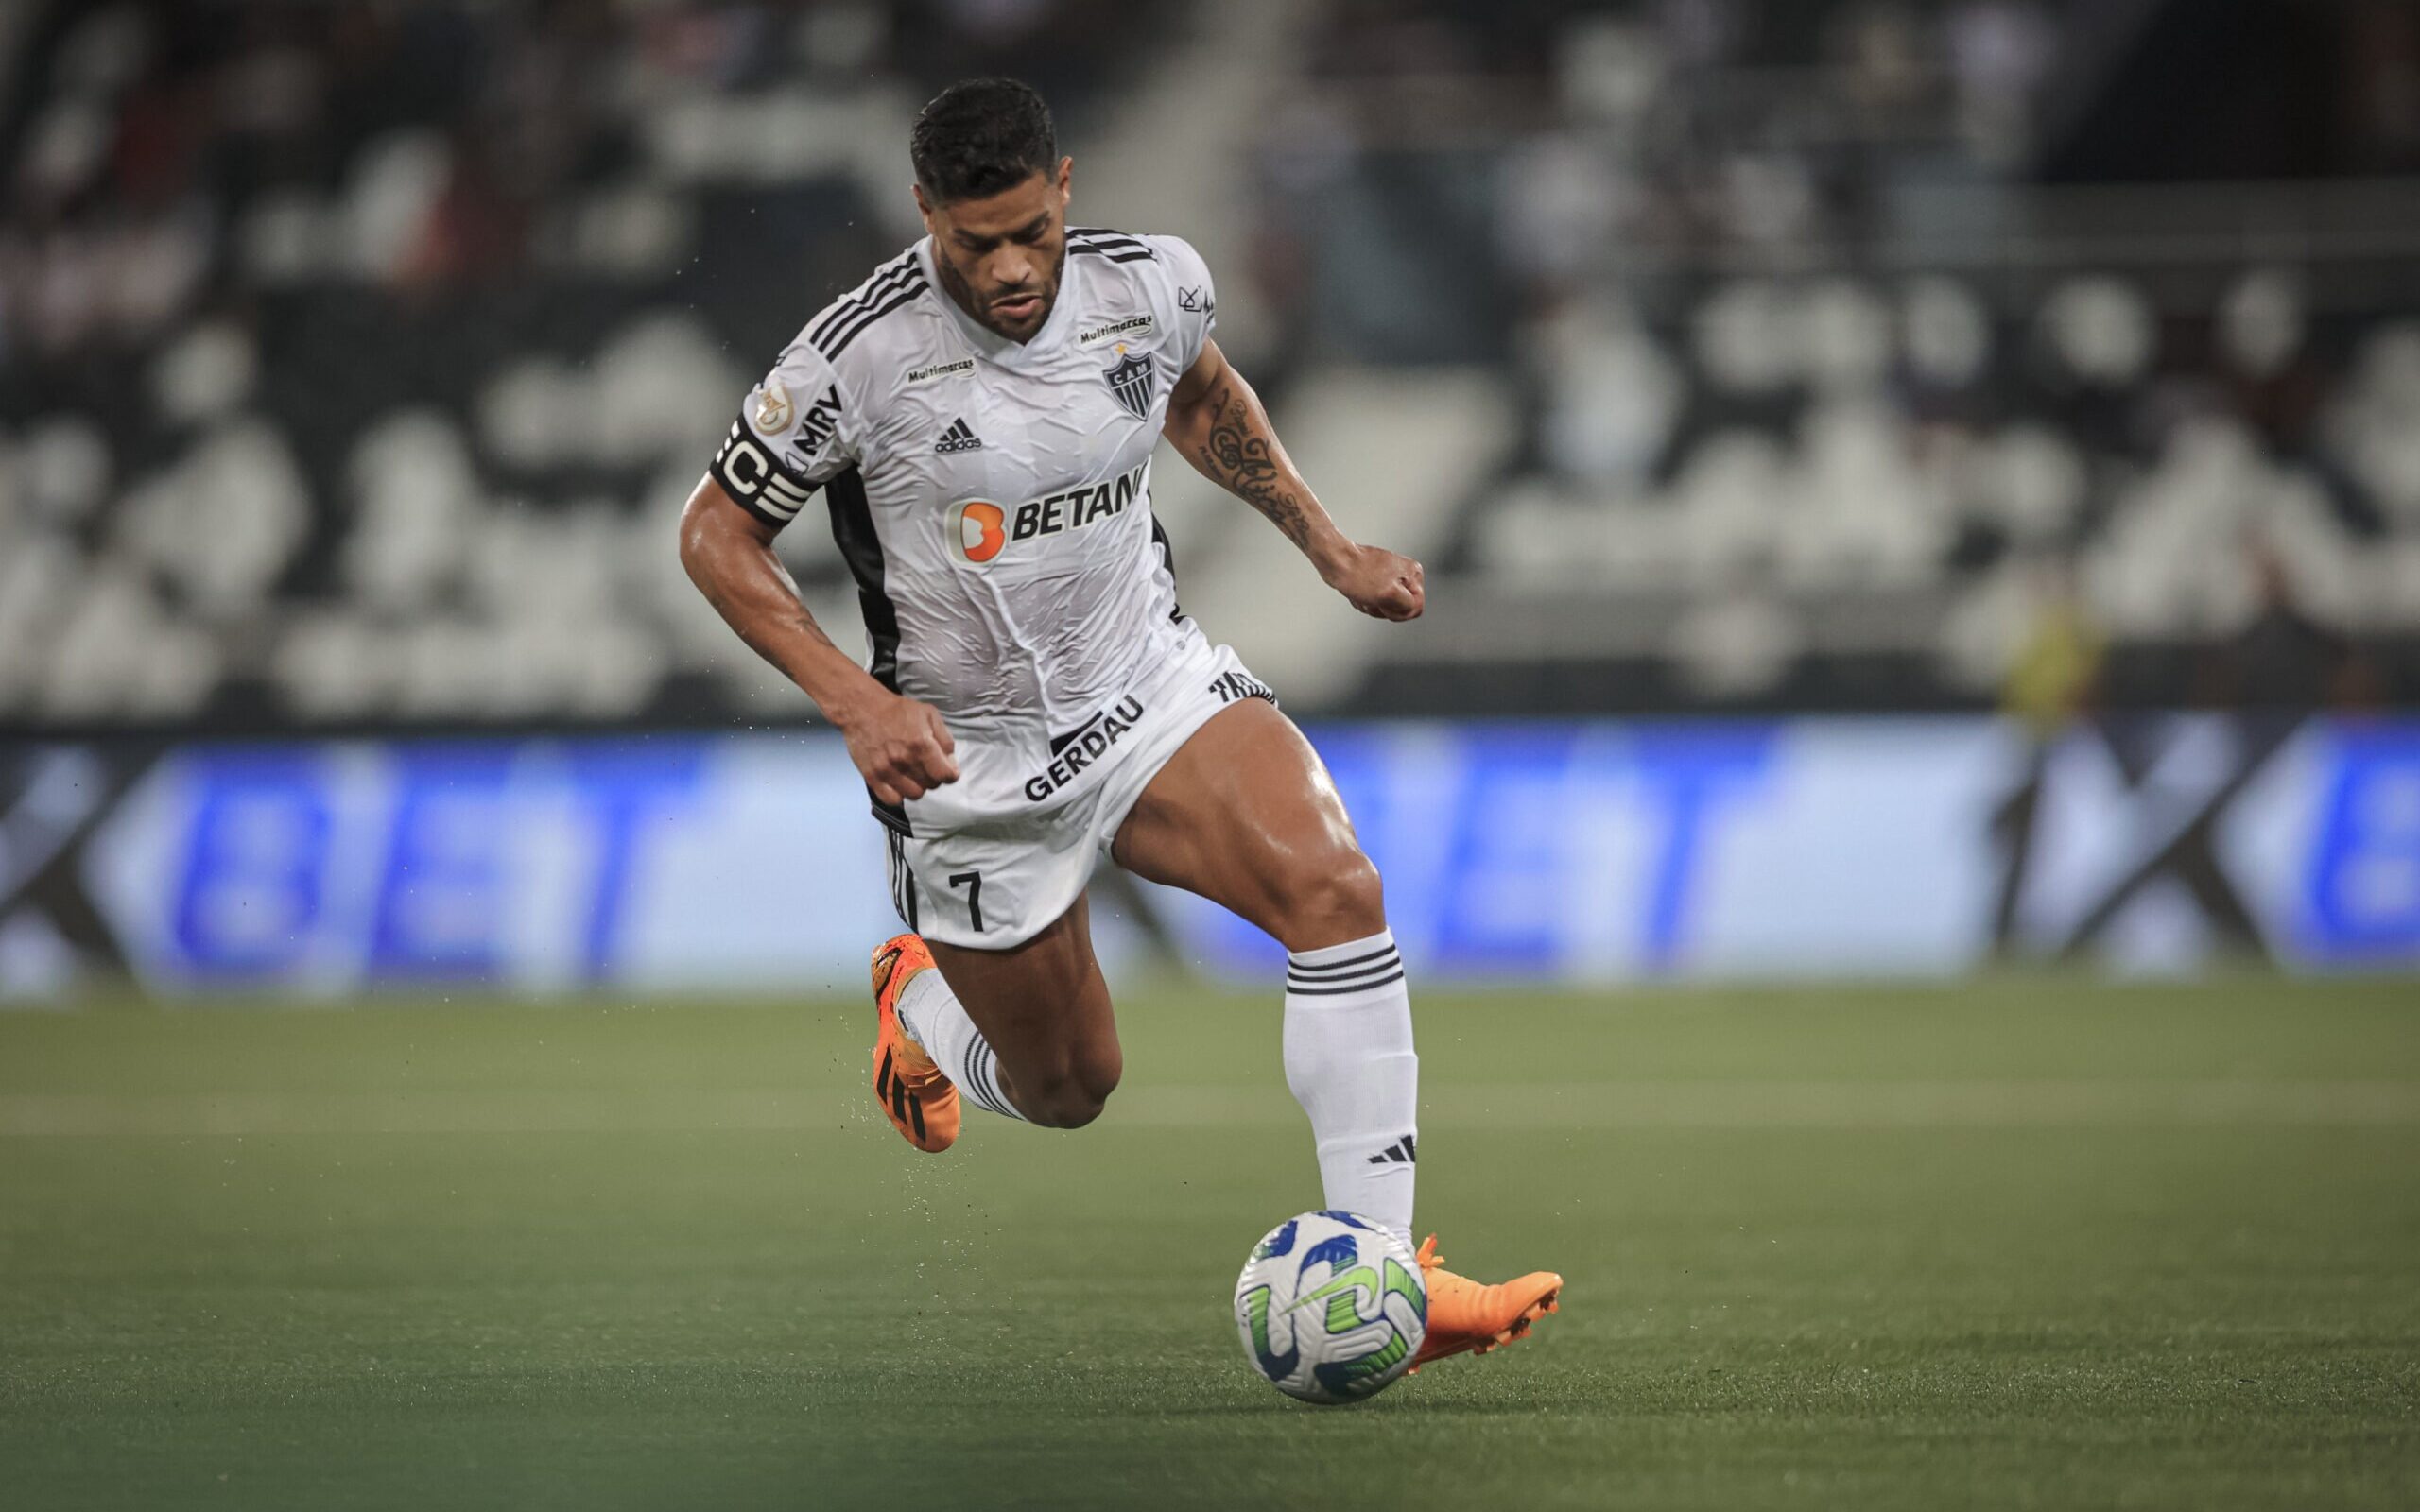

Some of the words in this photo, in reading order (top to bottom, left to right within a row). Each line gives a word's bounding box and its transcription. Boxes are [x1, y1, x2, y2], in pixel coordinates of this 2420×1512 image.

[1080, 315, 1152, 343] Multimarcas
[908, 359, 974, 383] Multimarcas
[1113, 362, 1148, 385] CAM
[793, 383, 843, 456] MRV
[934, 438, 981, 453] adidas
[723, 440, 769, 495] C
[1012, 459, 1149, 541] BETAN
[1024, 694, 1144, 802] GERDAU
[949, 871, 982, 933] 7
